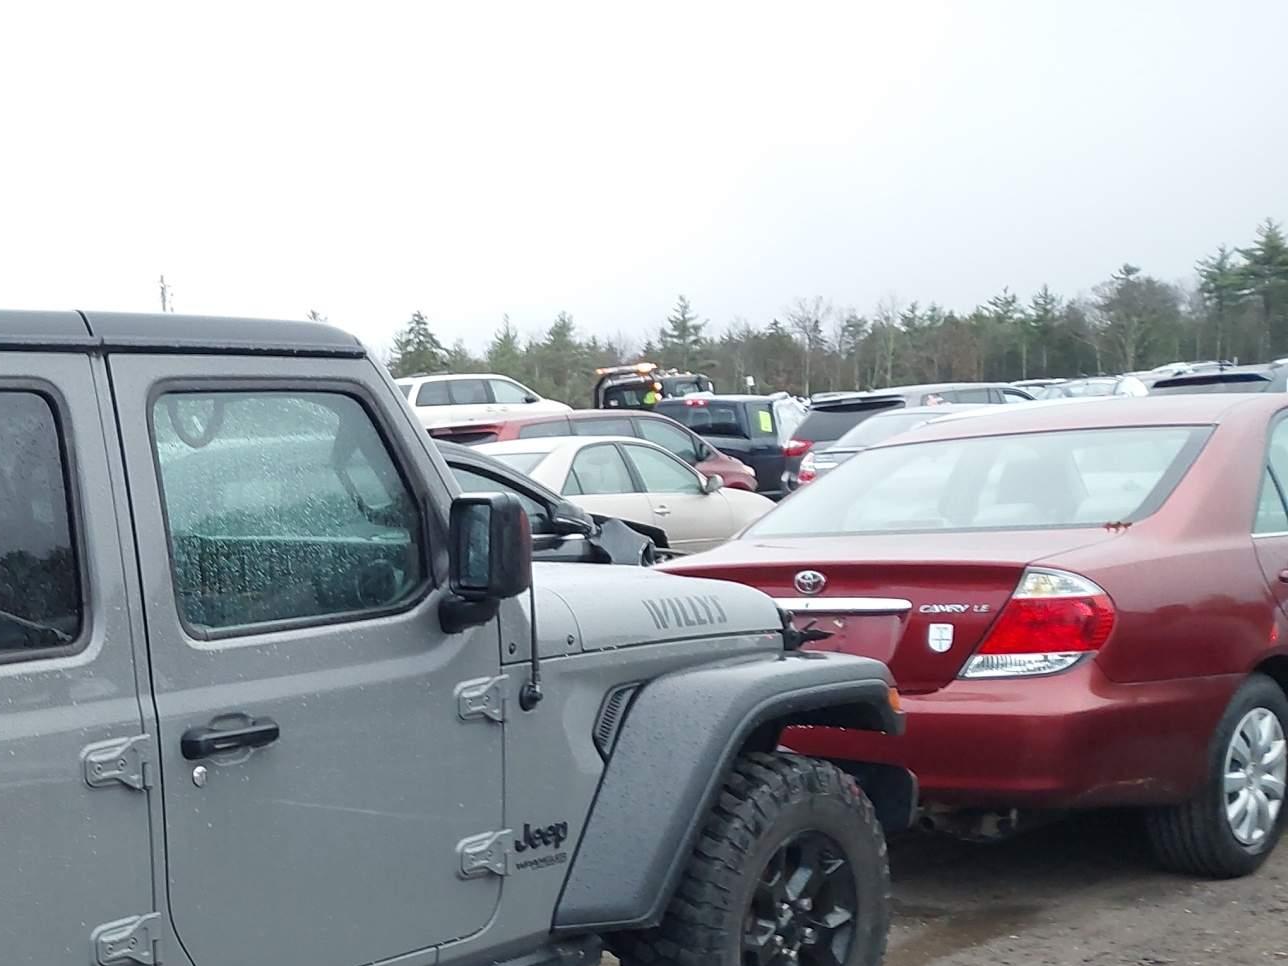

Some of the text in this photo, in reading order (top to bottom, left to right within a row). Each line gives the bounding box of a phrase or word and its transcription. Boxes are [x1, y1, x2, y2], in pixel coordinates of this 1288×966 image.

[641, 595, 728, 630] WILLYS
[918, 603, 971, 614] CAMRY
[514, 821, 568, 852] Jeep
